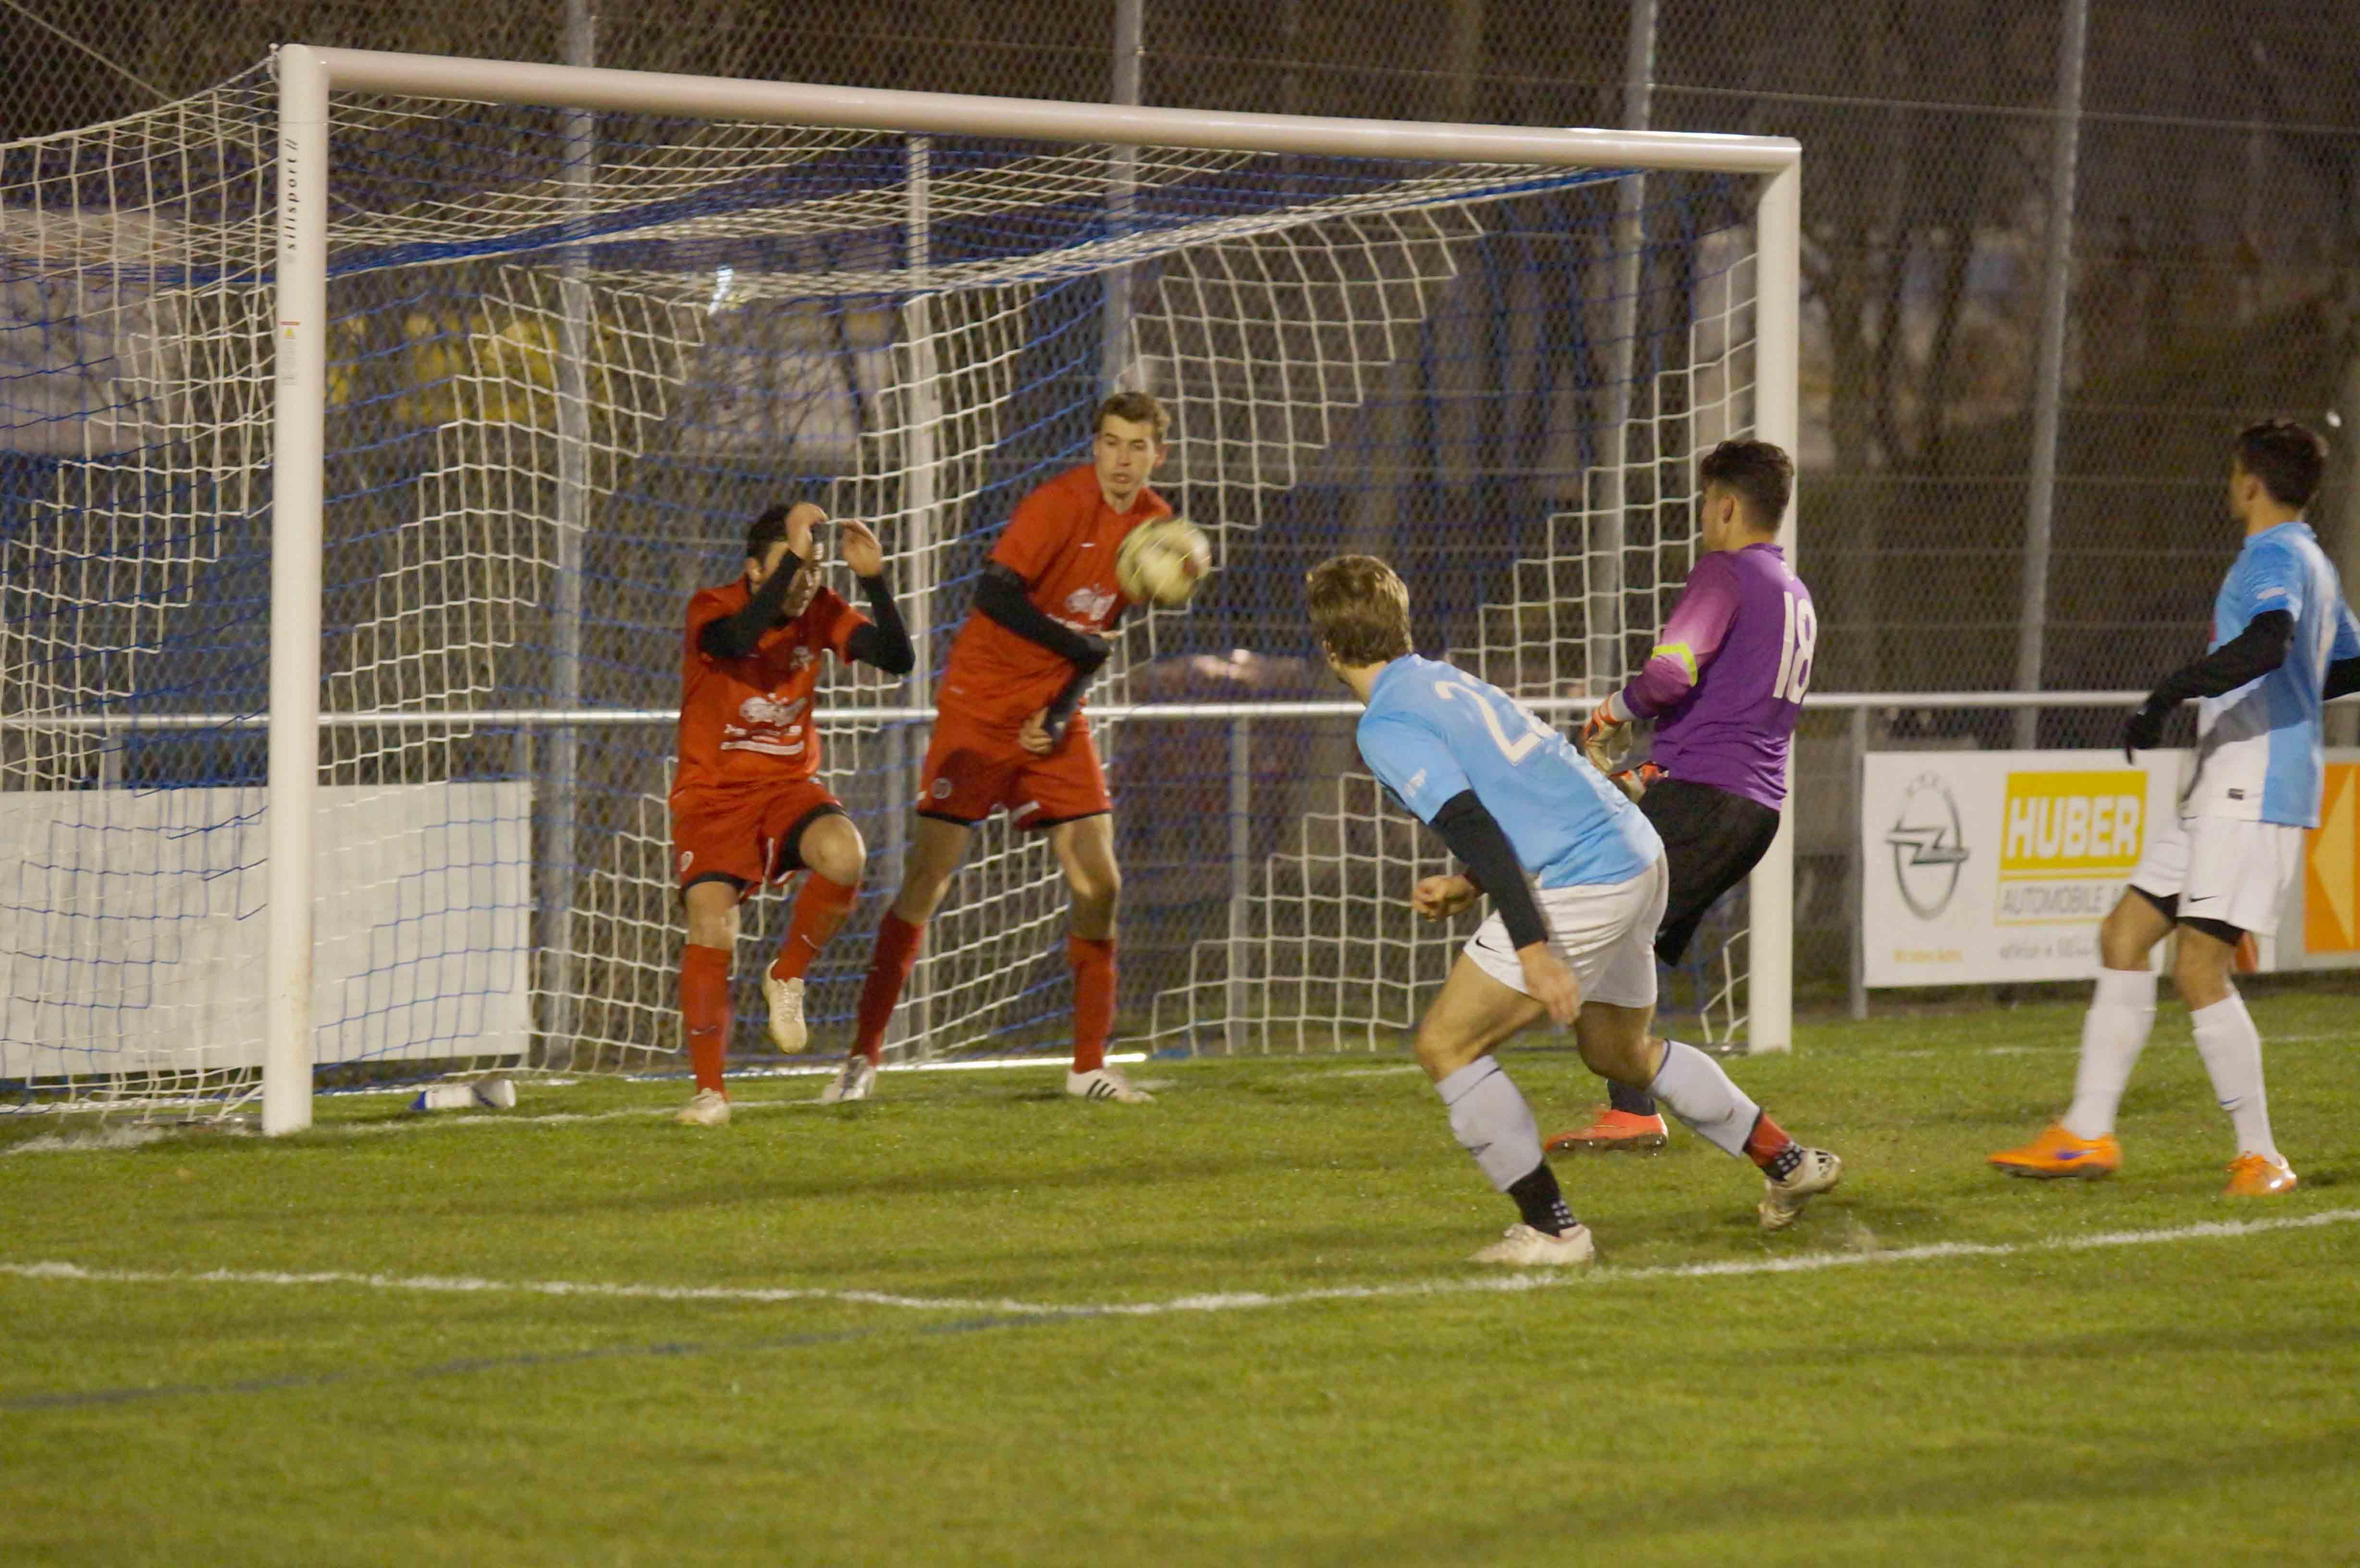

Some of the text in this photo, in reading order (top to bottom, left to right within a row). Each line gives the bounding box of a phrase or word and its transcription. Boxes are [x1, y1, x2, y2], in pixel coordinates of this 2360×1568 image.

[1773, 591, 1817, 704] 18
[2006, 795, 2139, 860] HUBER
[2000, 885, 2103, 915] AUTOMOBILE
